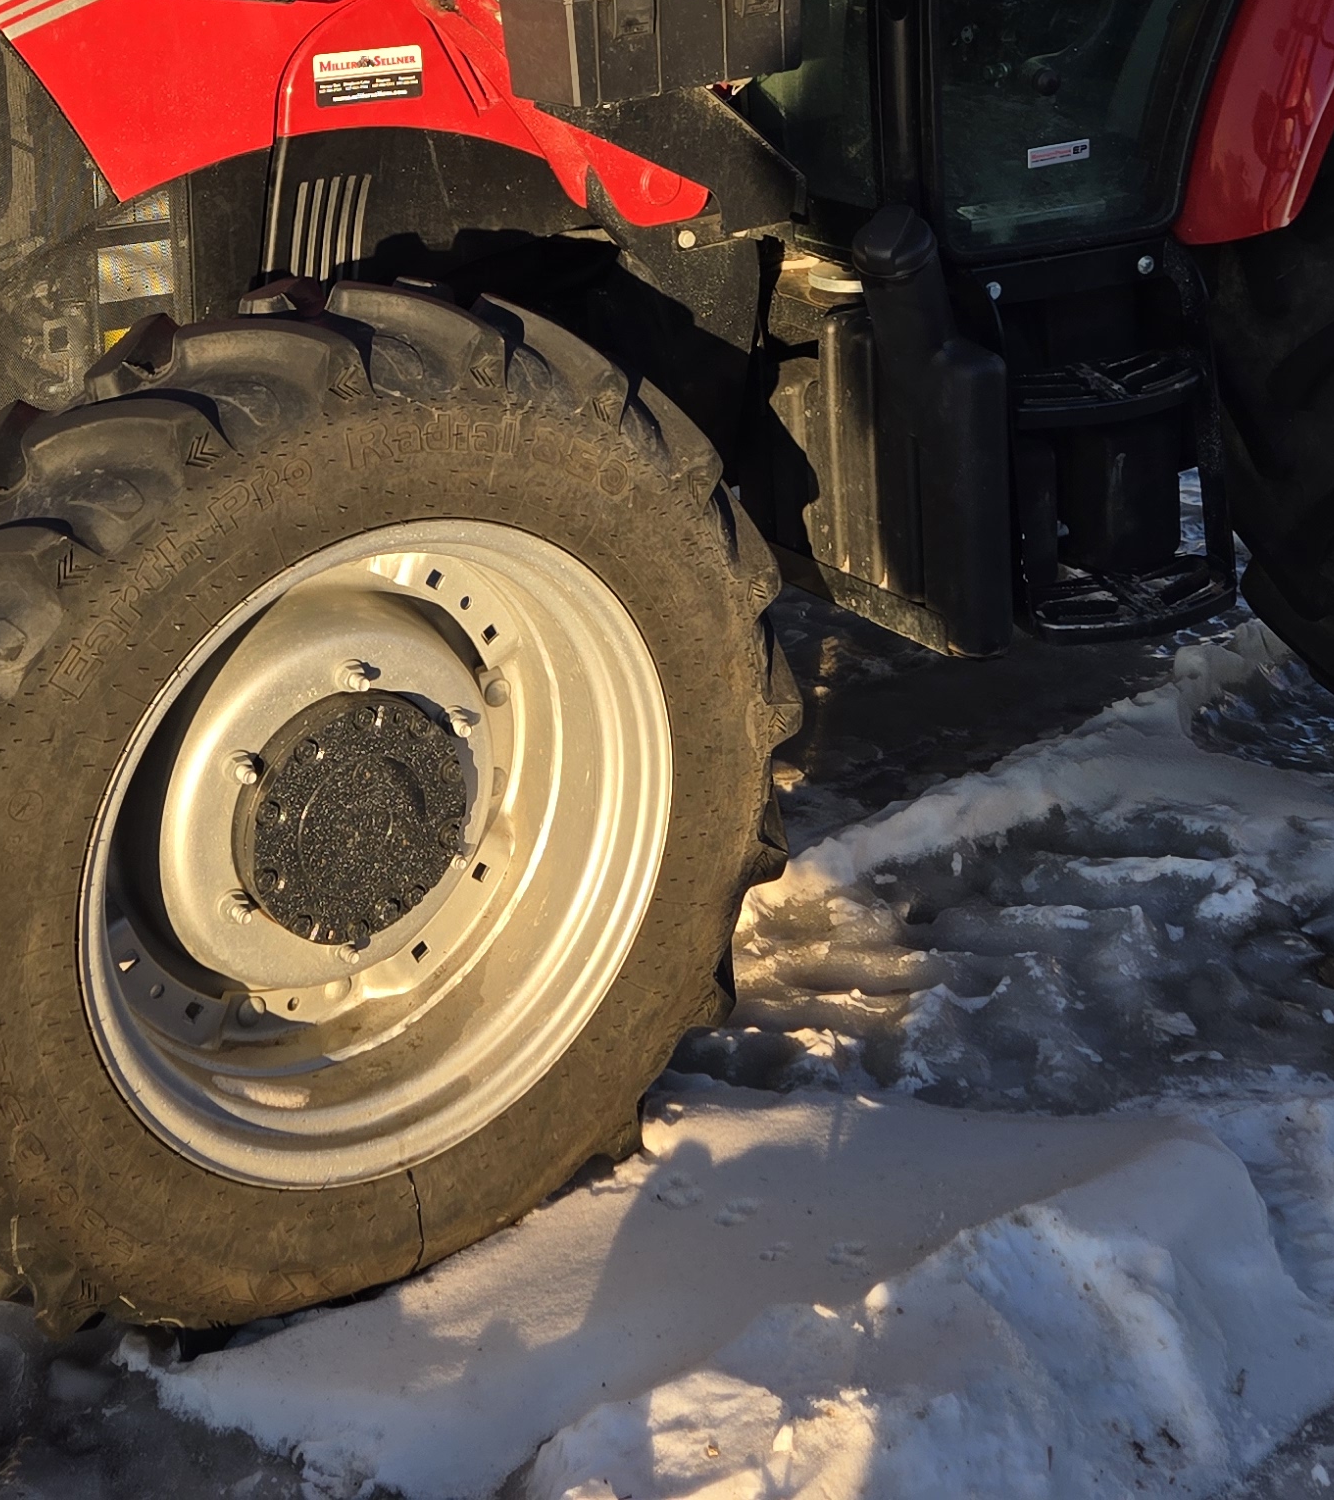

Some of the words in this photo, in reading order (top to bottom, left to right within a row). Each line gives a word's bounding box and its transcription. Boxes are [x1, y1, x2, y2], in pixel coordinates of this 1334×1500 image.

[319, 61, 358, 72] MILLER
[373, 55, 416, 67] SELLNER
[345, 411, 520, 470] Radial
